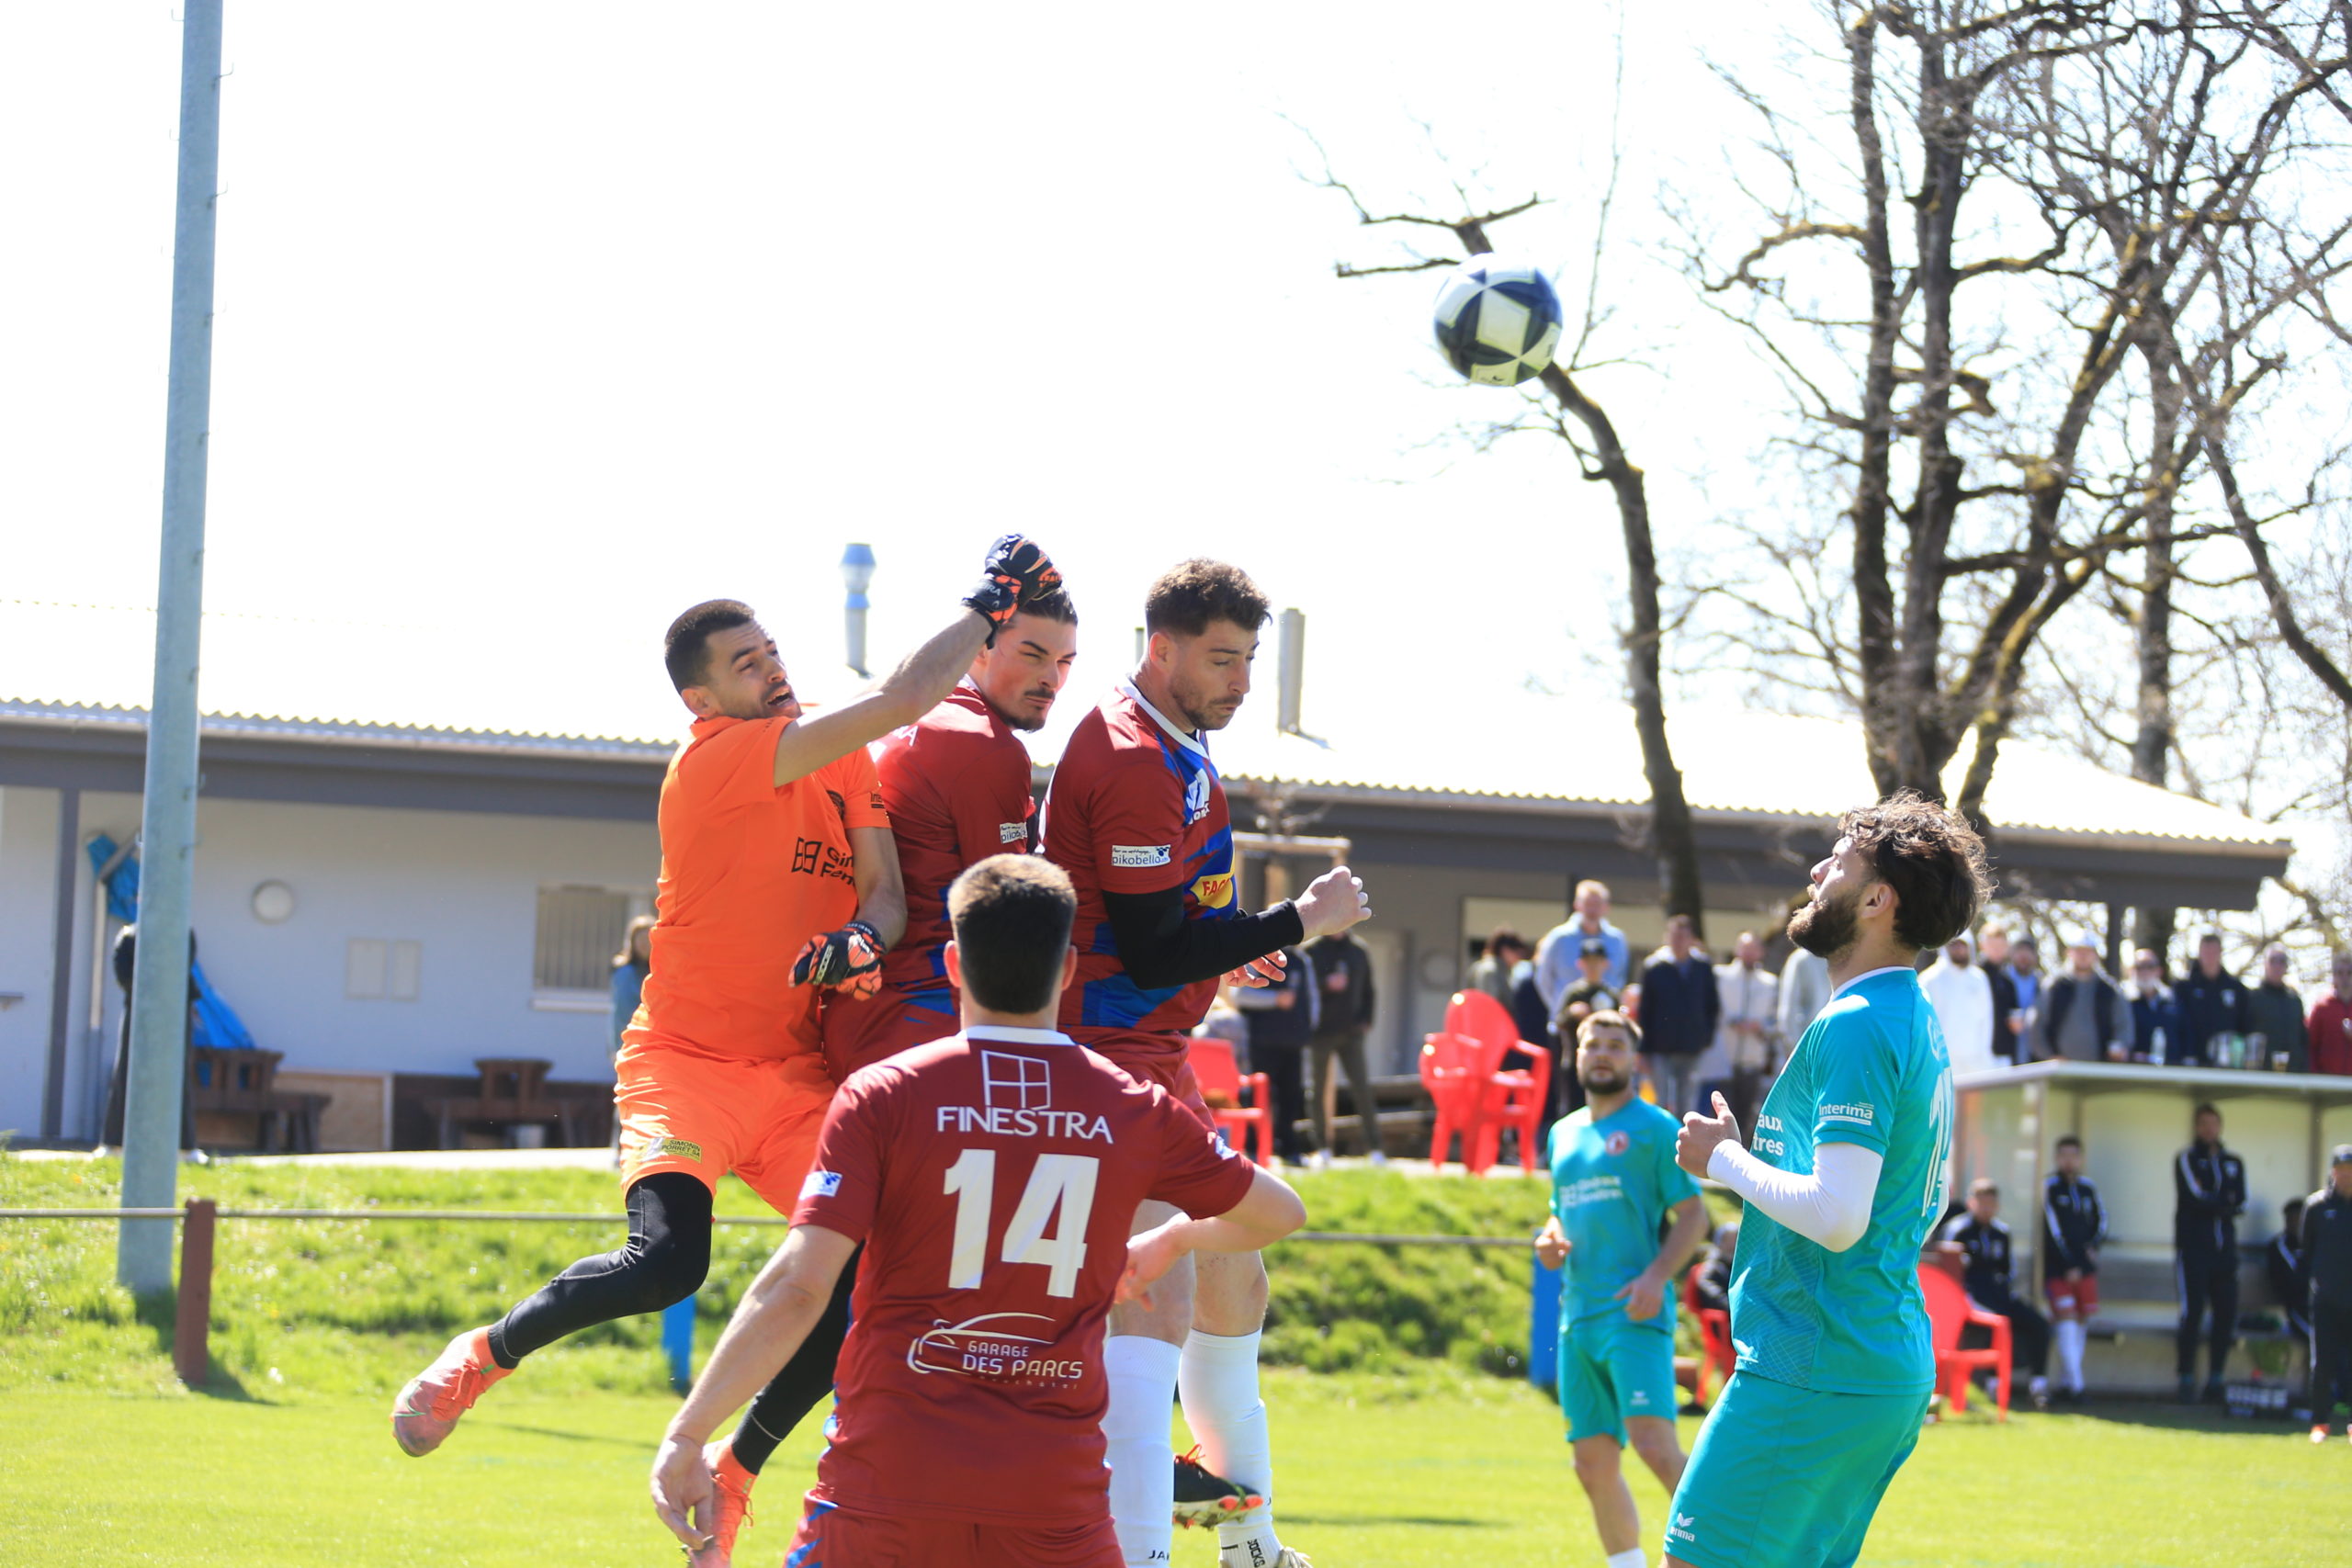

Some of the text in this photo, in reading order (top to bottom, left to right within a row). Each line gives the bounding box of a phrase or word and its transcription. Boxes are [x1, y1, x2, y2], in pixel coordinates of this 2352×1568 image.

[1819, 1102, 1874, 1120] Interima
[936, 1106, 1114, 1145] FINESTRA
[943, 1148, 1101, 1299] 14
[967, 1340, 1030, 1357] GARAGE
[962, 1353, 1084, 1379] DES PARCS
